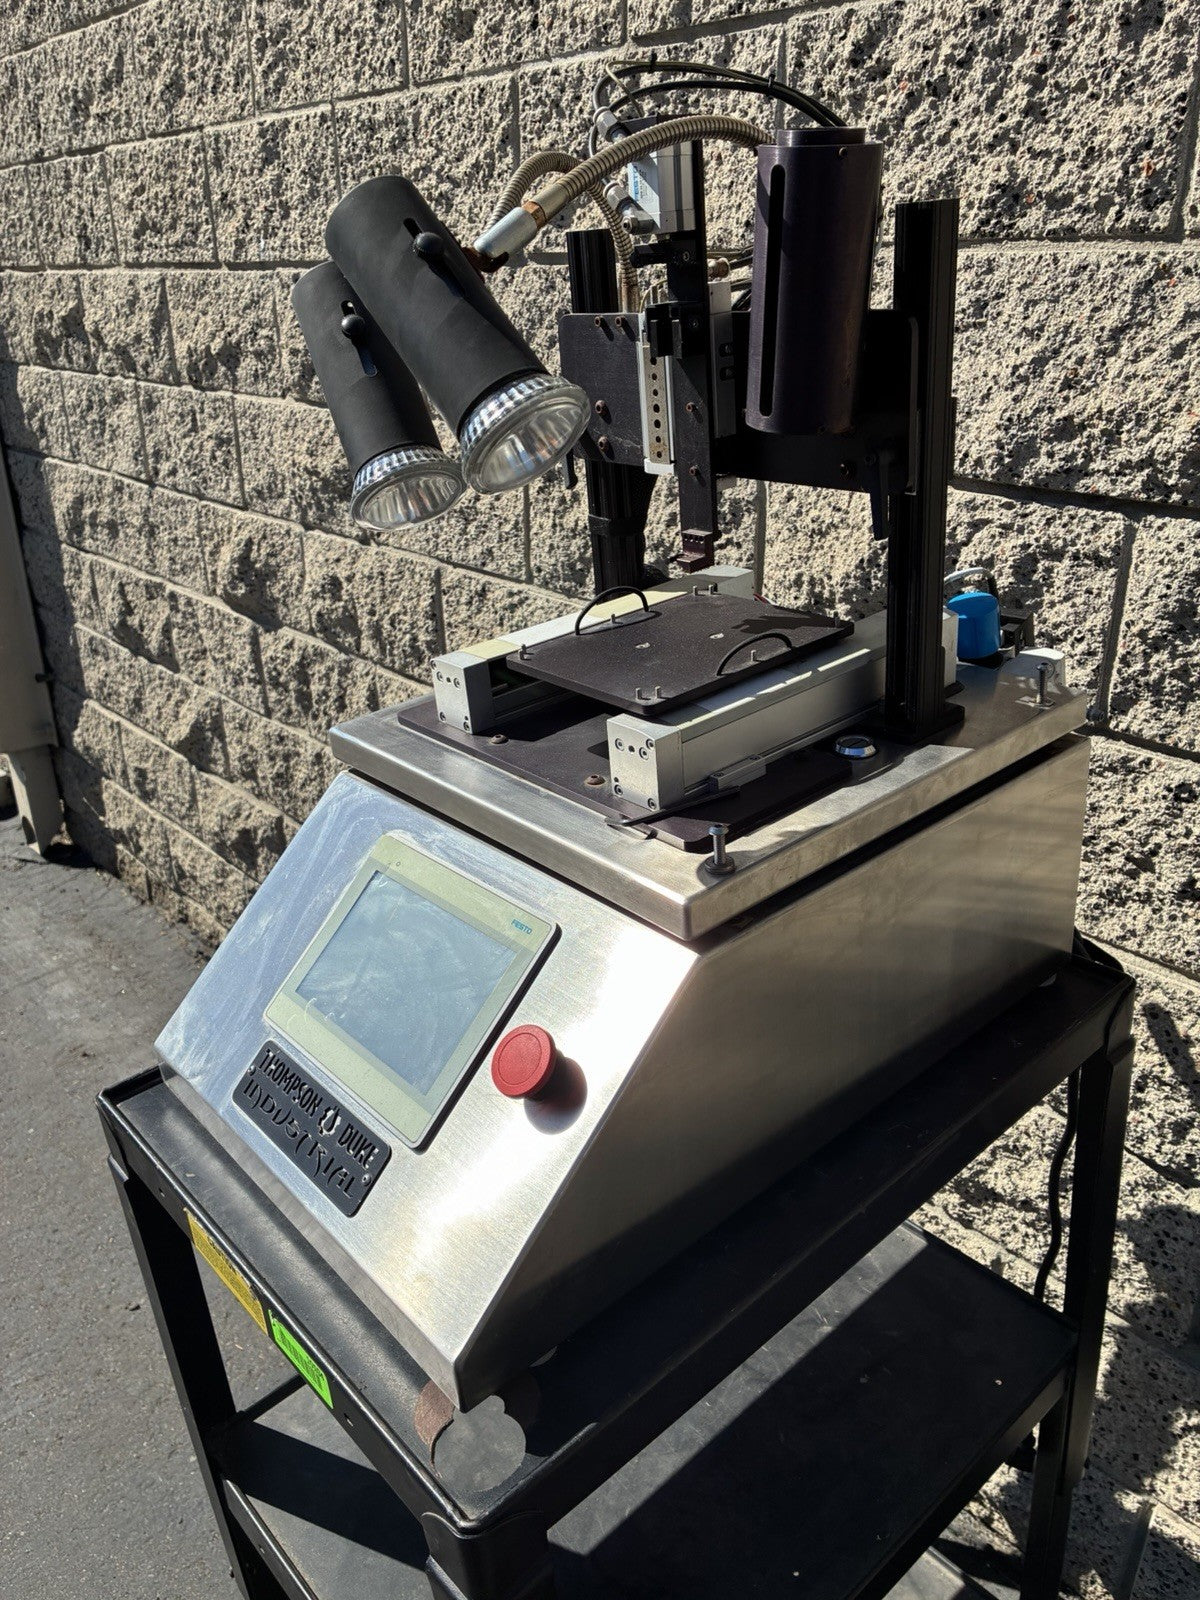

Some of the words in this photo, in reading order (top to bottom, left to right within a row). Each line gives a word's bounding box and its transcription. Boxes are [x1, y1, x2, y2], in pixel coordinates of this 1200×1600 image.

[511, 919, 532, 935] FESTO
[243, 1079, 356, 1198] INDUSTRIAL
[259, 1048, 323, 1118] THOMPSON
[337, 1123, 379, 1170] DUKE
